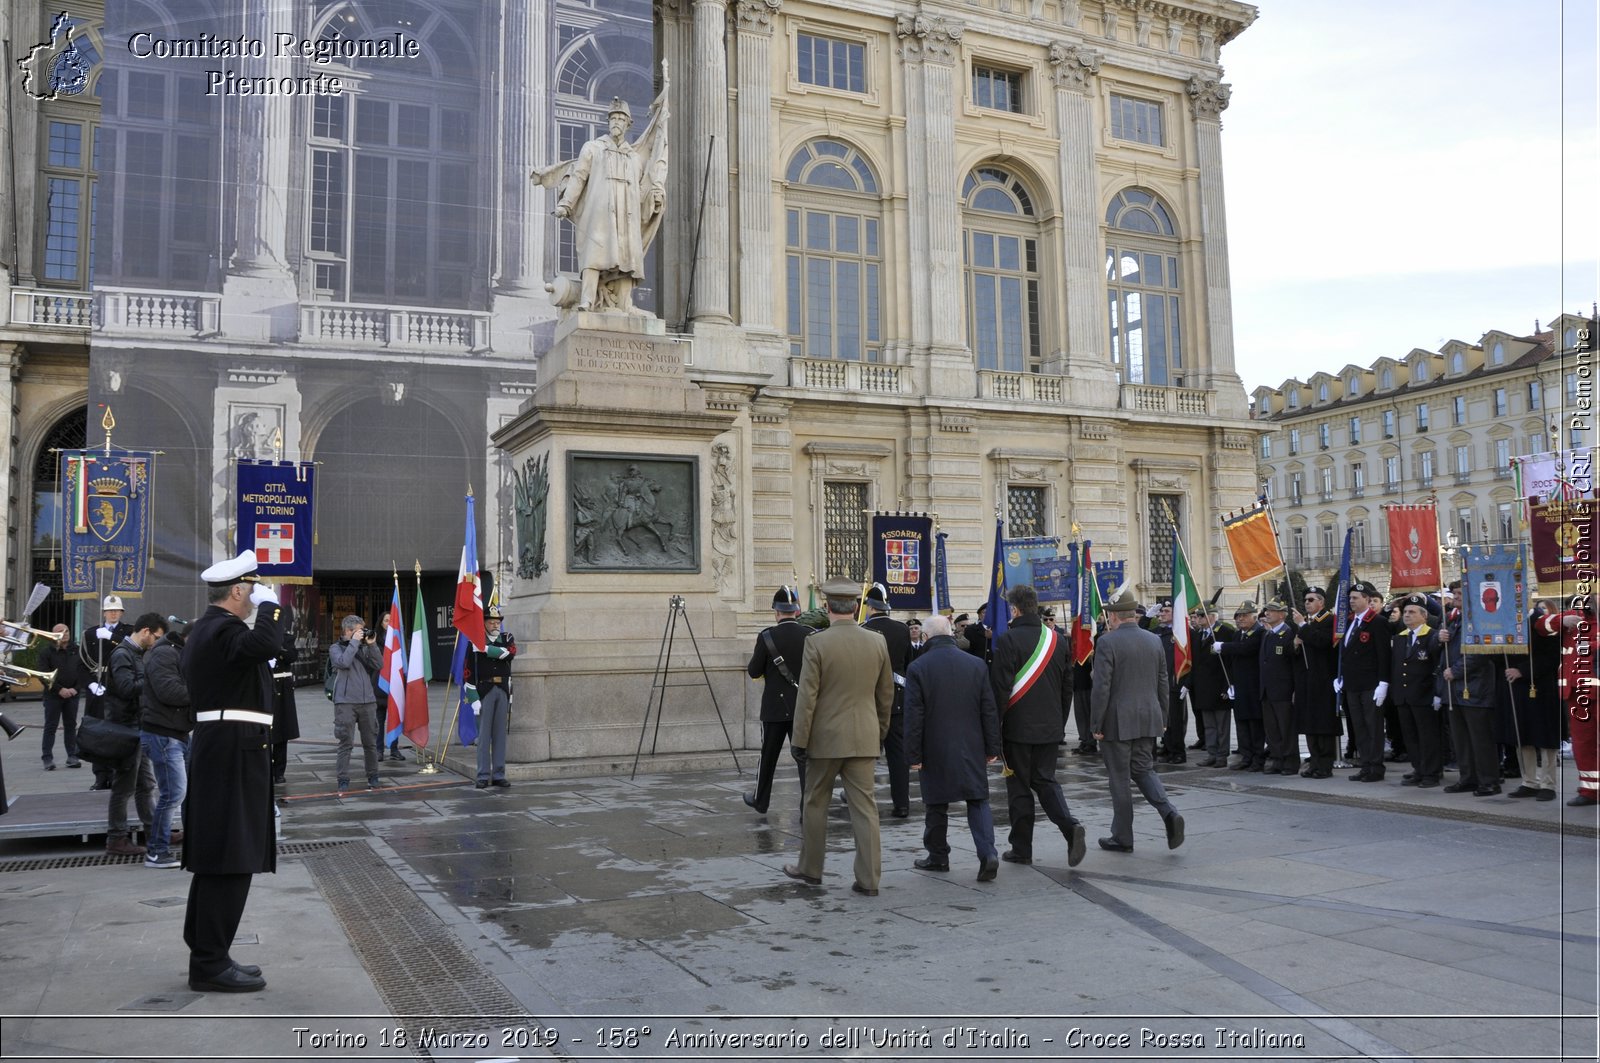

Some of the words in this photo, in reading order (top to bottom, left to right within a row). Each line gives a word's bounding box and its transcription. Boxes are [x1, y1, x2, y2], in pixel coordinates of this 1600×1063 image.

[597, 349, 642, 361] ESERCITO
[647, 354, 680, 364] SARDO
[265, 483, 287, 493] CITTÀ
[243, 493, 307, 504] METROPOLITANA
[256, 506, 264, 515] DI
[266, 506, 295, 516] TORINO
[881, 530, 922, 540] ASSOARMA
[889, 586, 915, 594] TORINO
